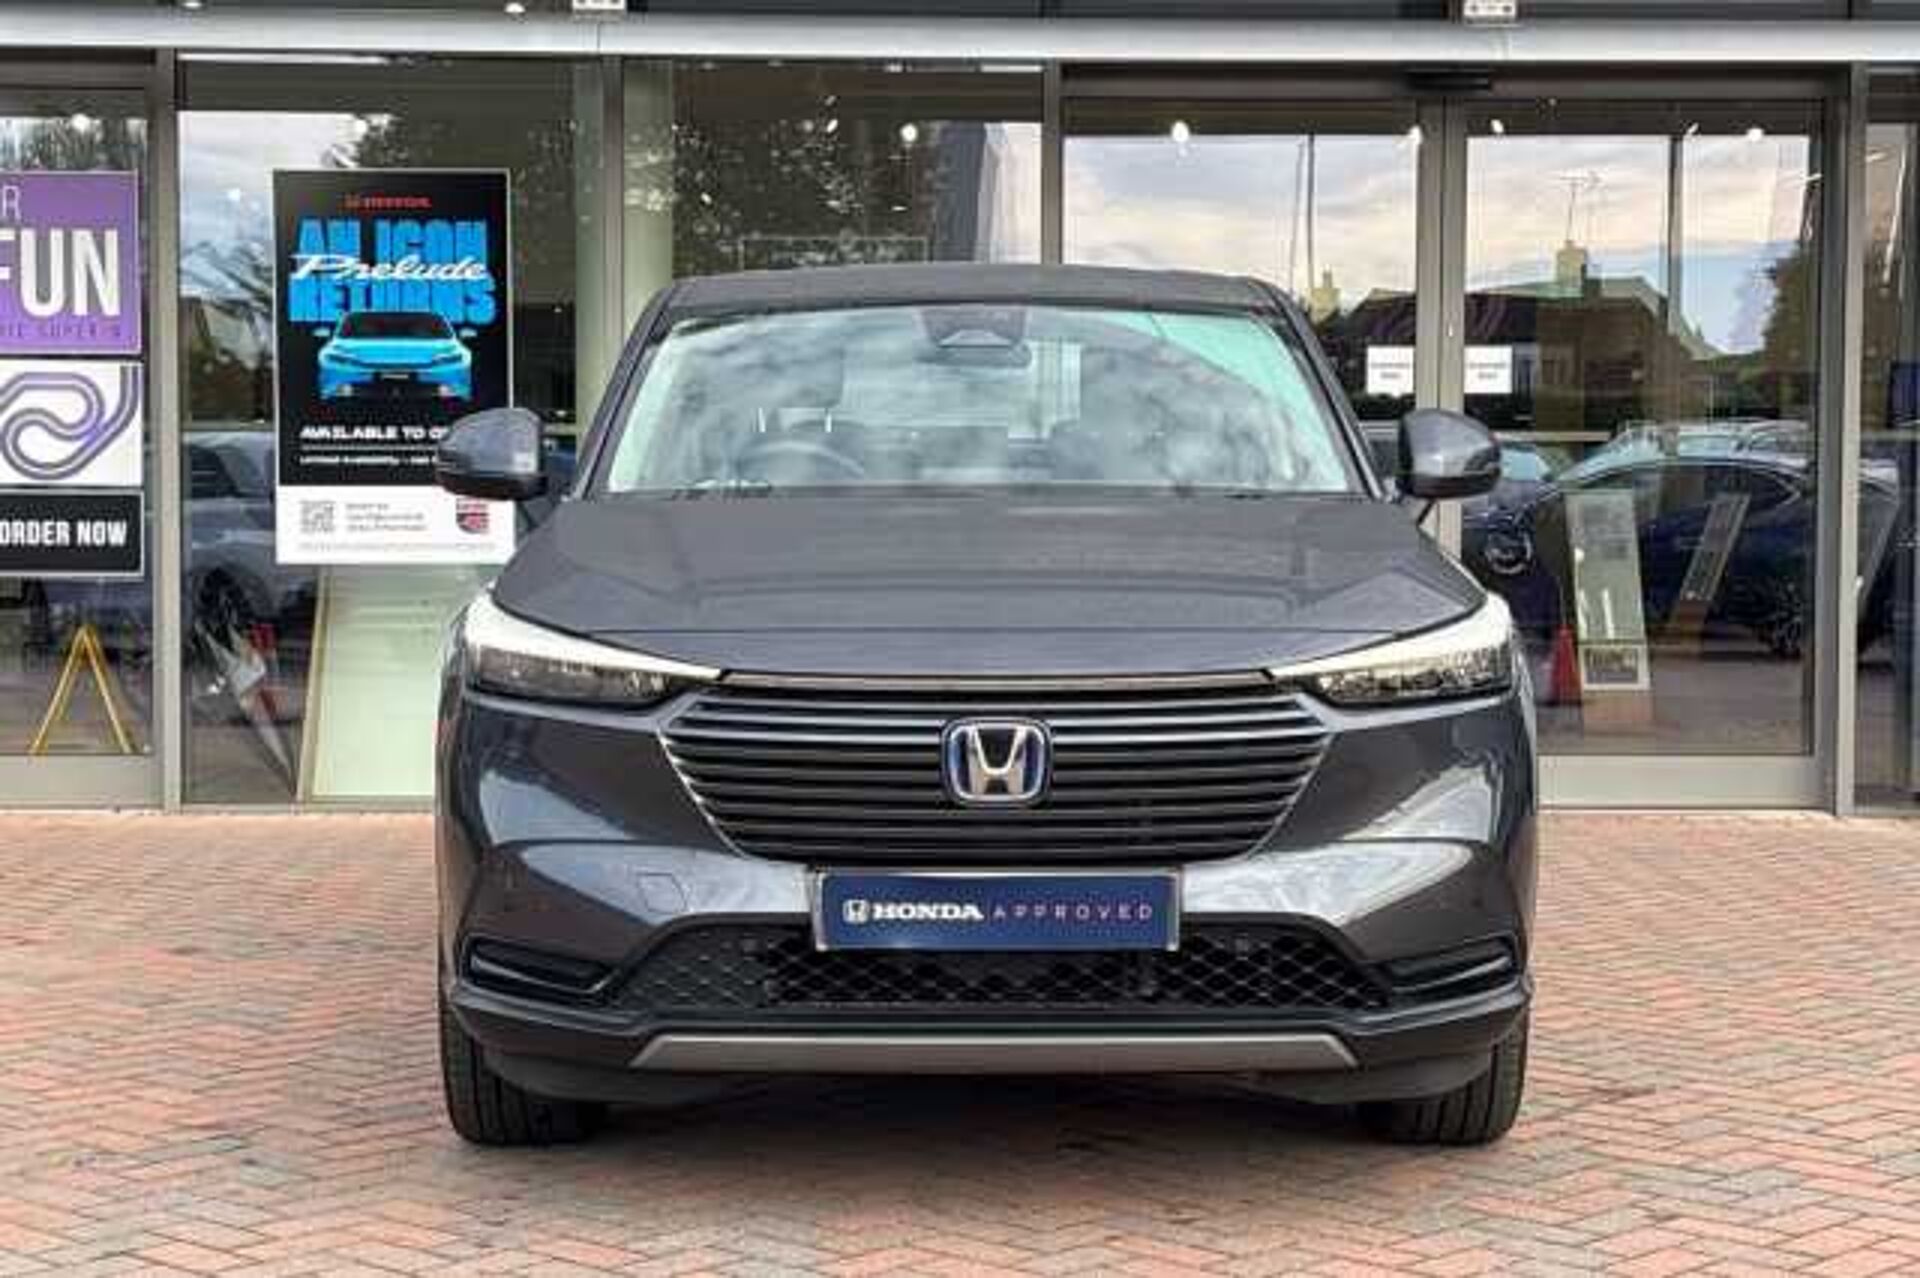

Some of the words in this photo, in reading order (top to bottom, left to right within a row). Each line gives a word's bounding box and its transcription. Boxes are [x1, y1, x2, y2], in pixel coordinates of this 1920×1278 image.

[300, 218, 361, 254] AN
[290, 253, 488, 280] Prelude
[300, 425, 398, 439] AVAILABLE
[401, 425, 426, 439] TO
[0, 520, 70, 546] ORDER
[76, 520, 127, 546] NOW
[872, 901, 984, 919] HONDA
[993, 900, 1153, 920] APPROVED
